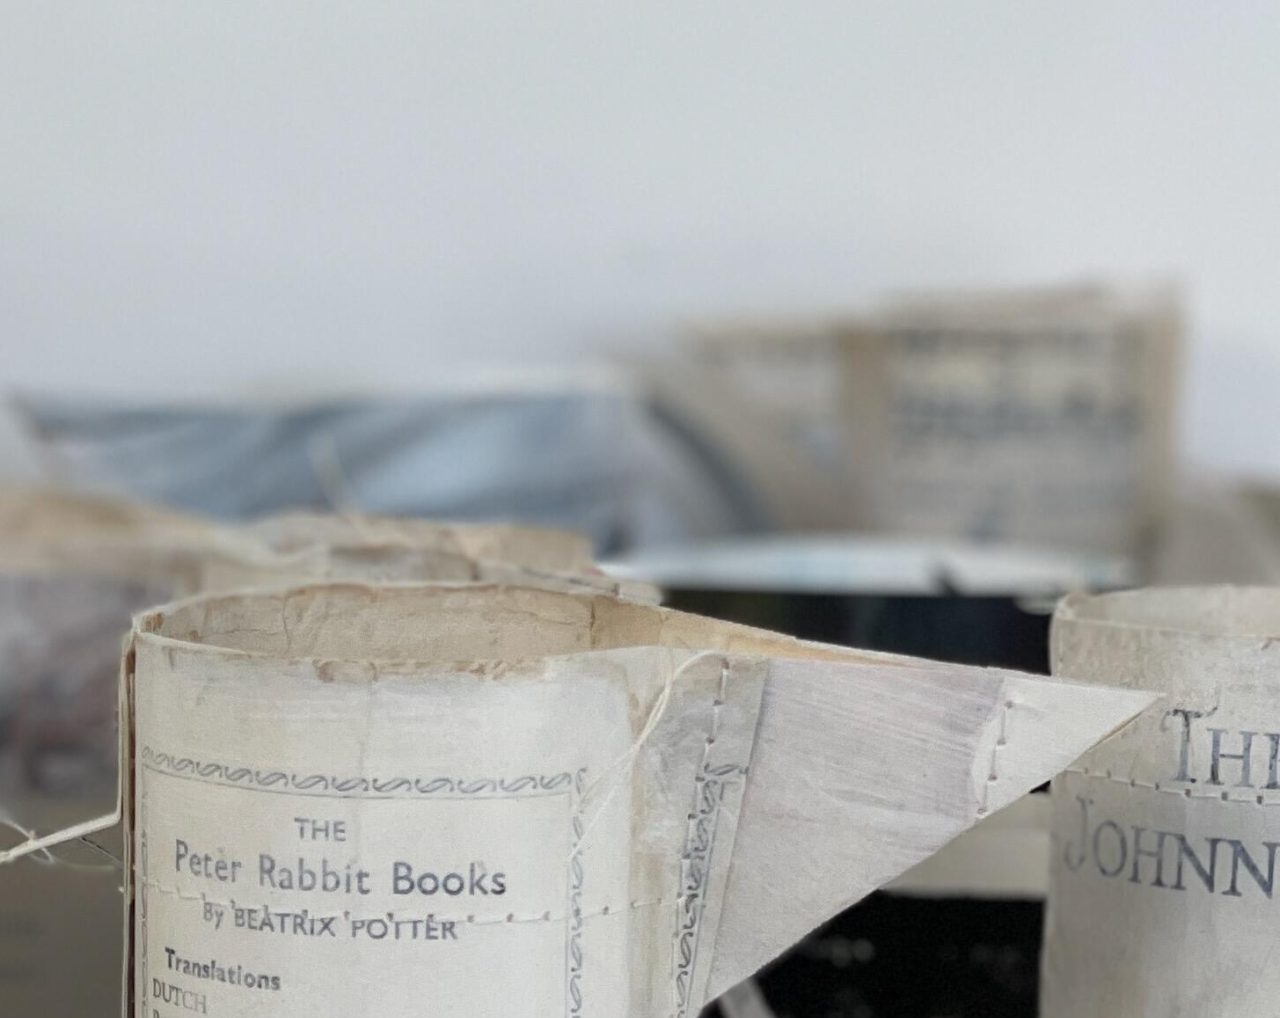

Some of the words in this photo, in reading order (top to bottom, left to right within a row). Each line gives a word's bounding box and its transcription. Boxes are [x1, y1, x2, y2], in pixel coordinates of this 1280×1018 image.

[294, 817, 347, 841] THE
[175, 838, 242, 883] Peter
[258, 853, 370, 895] Rabbit
[392, 861, 508, 897] Books
[202, 900, 224, 930] By
[233, 907, 337, 938] BEATRIX
[350, 917, 459, 941] POTTER
[165, 946, 281, 991] Translations
[152, 977, 207, 1014] DUTCH
